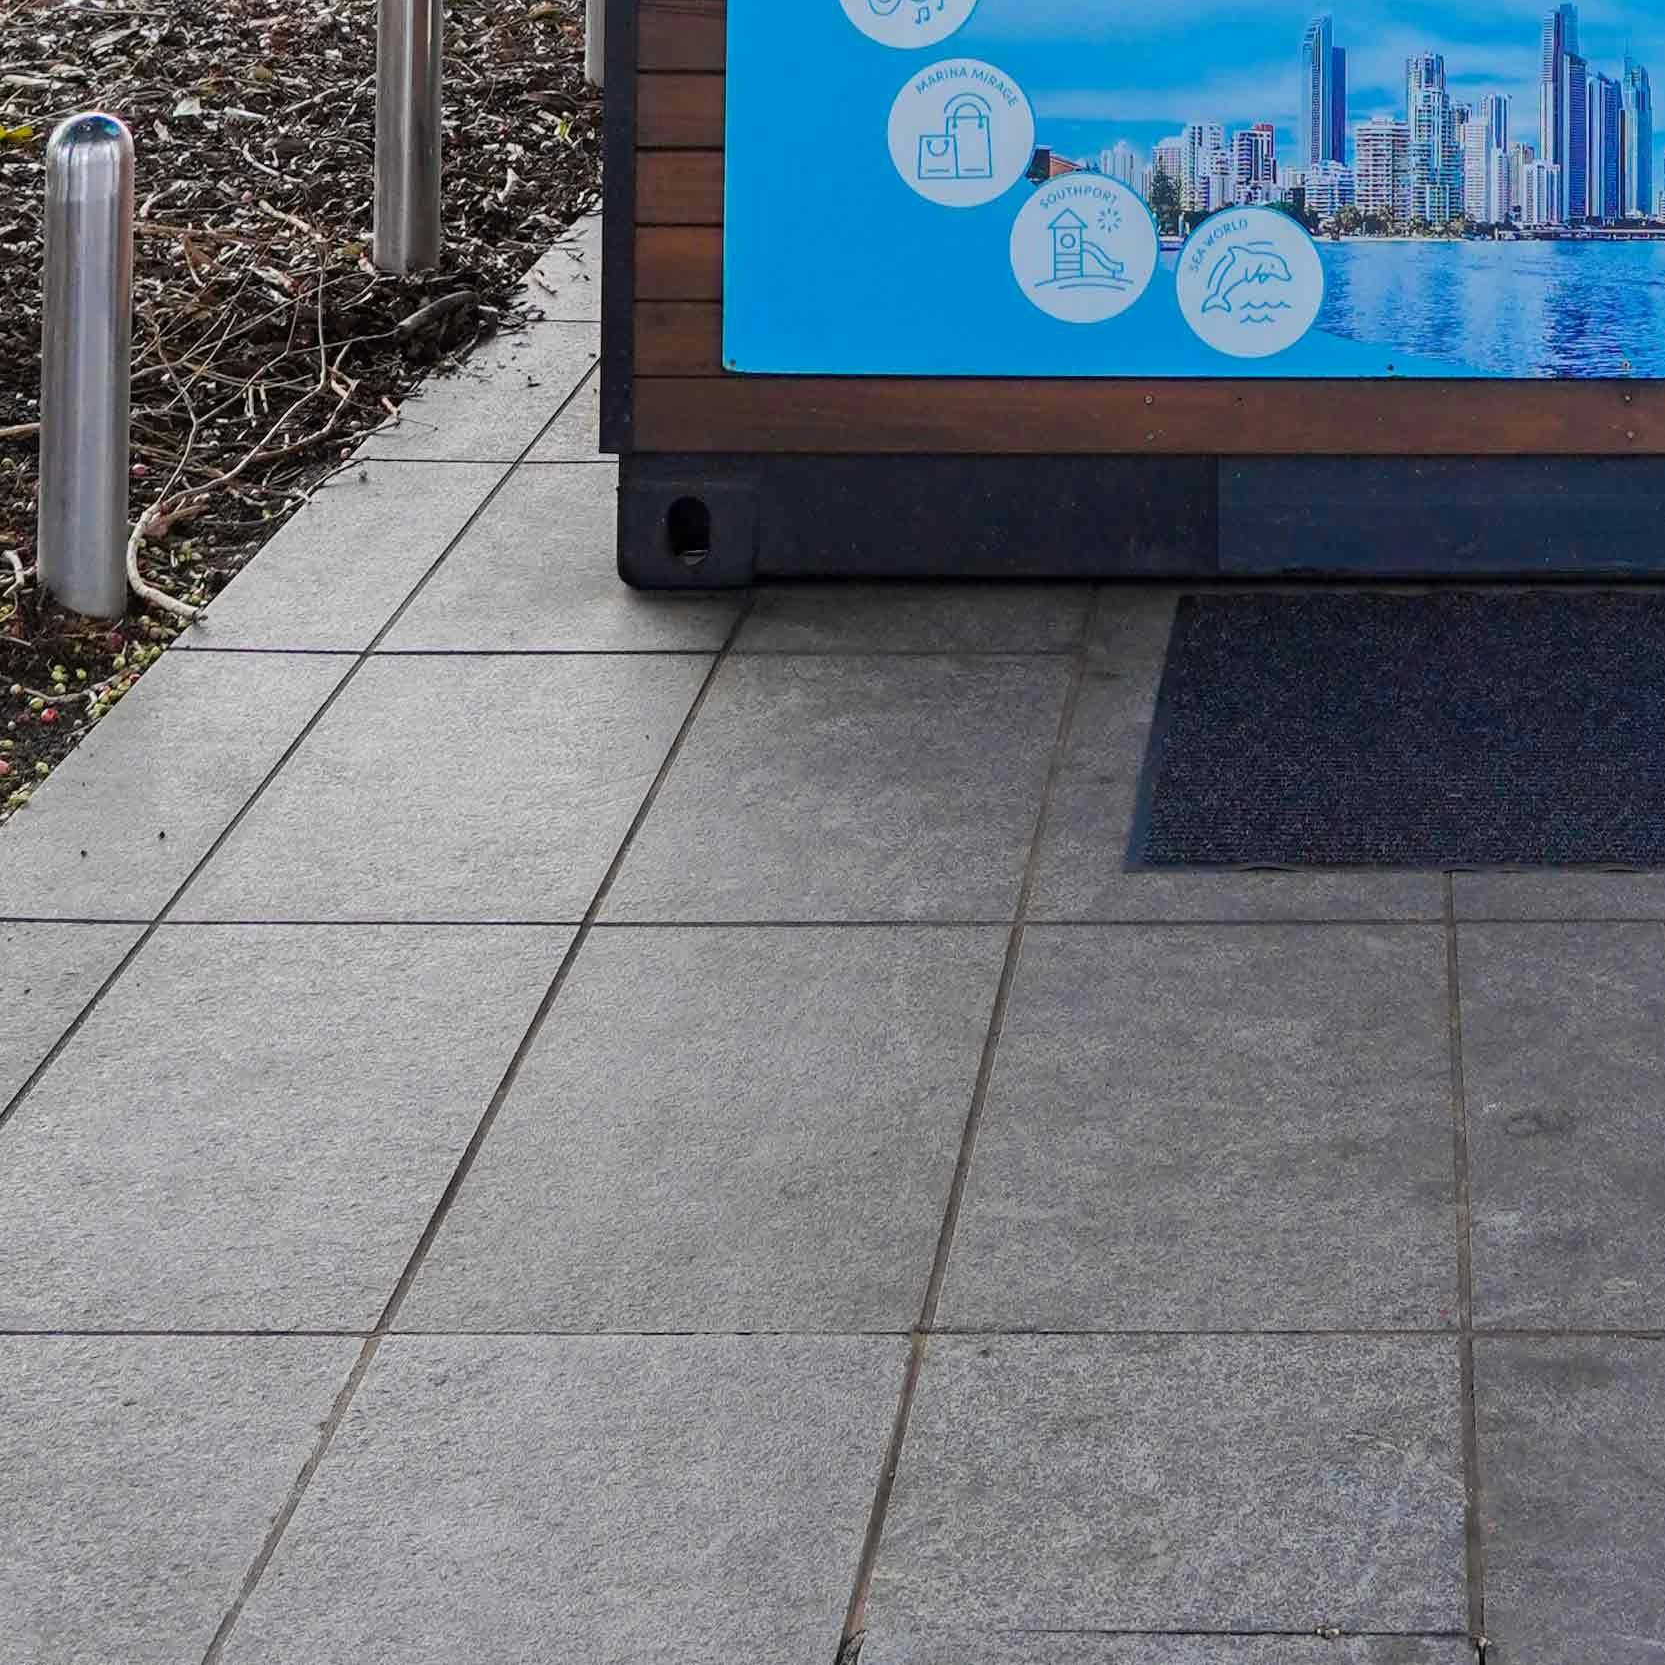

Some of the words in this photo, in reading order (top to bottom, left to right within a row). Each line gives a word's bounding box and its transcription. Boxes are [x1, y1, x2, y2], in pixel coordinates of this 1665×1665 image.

[914, 67, 968, 95] MARINA
[970, 68, 1019, 107] MIRAGE
[1040, 185, 1118, 209] SOUTHPORT
[1190, 247, 1207, 273] SEA
[1203, 219, 1248, 247] WORLD
